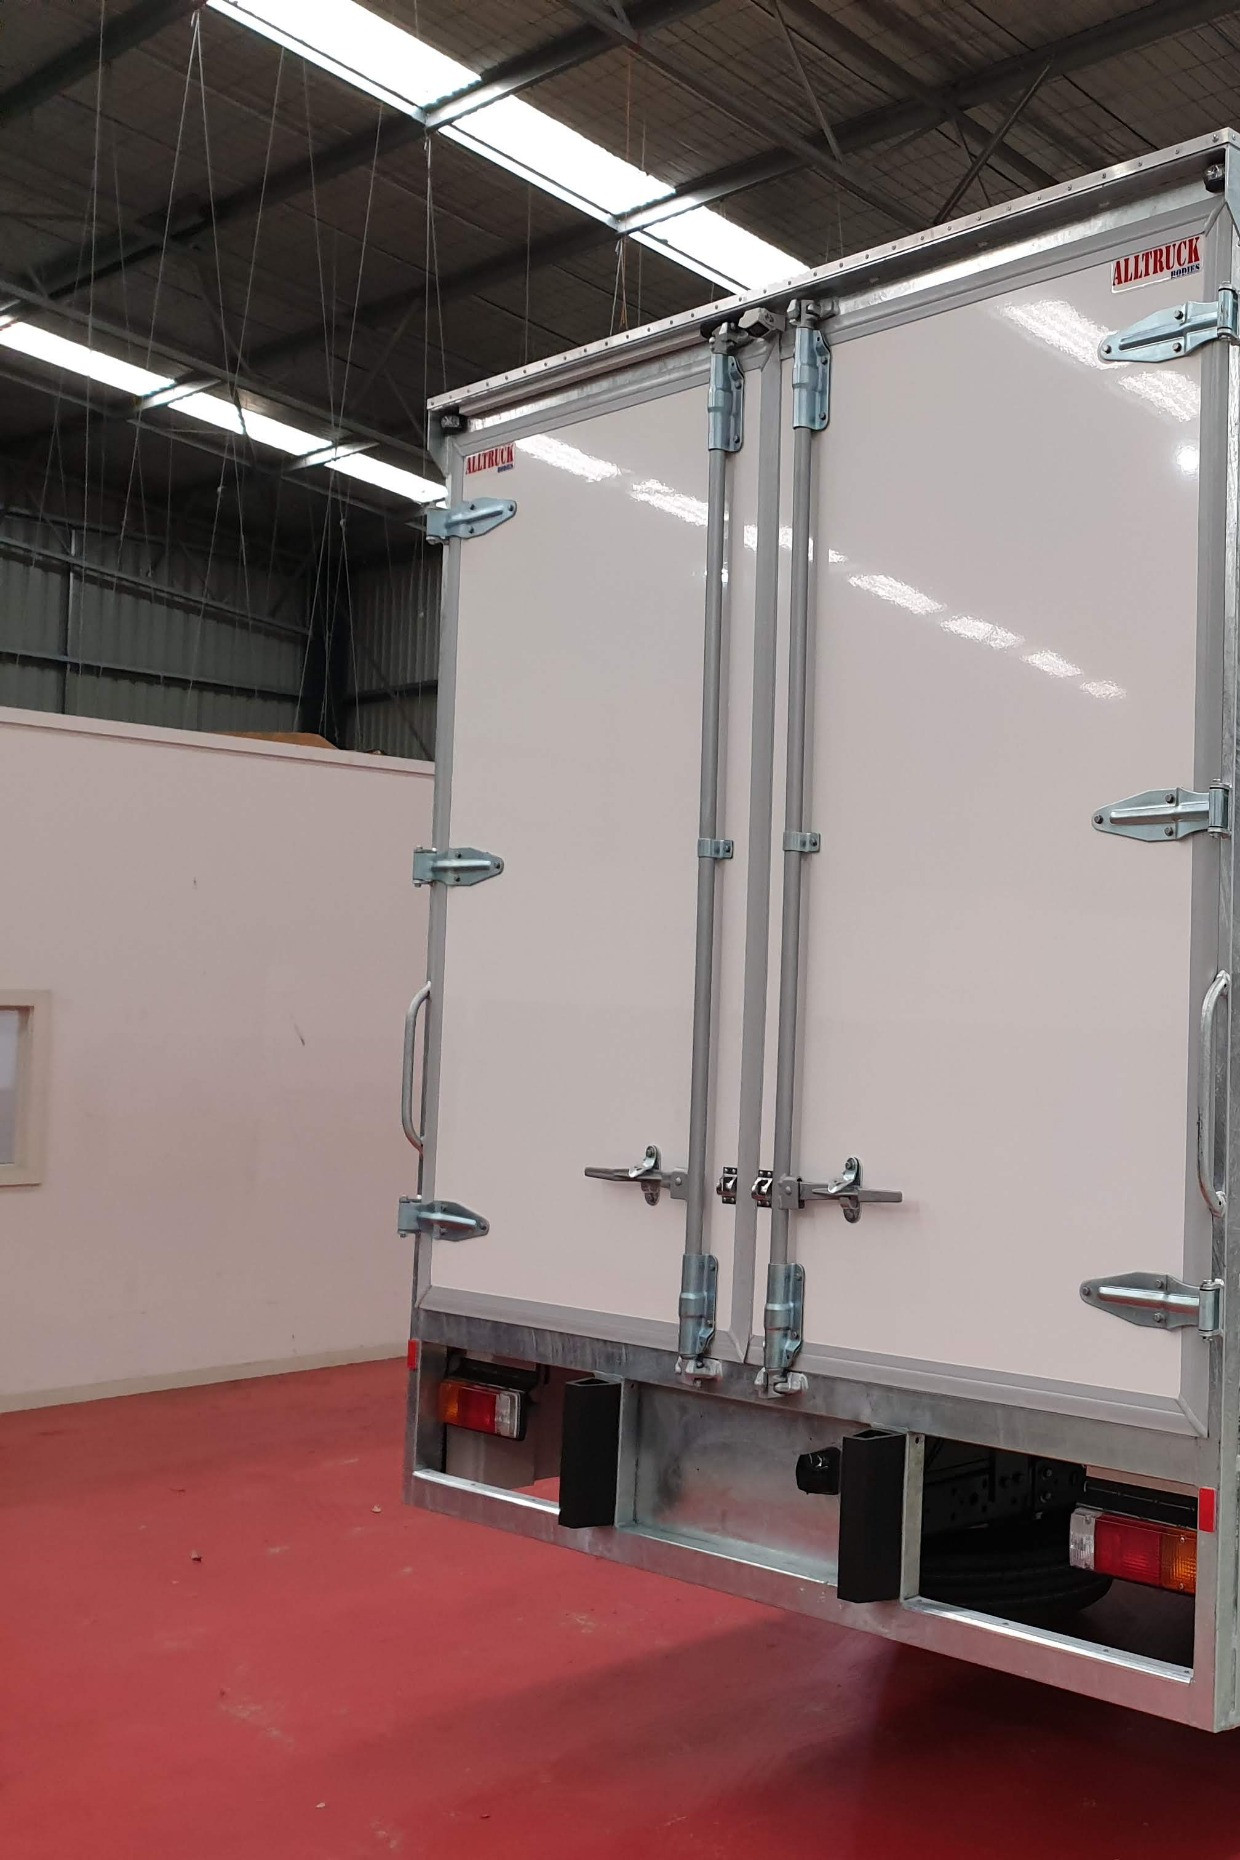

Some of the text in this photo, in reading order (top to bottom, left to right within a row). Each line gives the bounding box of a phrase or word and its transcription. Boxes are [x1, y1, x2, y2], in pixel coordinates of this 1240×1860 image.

[1113, 236, 1200, 286] ALLTRUCK
[1170, 264, 1200, 280] BODIES
[465, 444, 513, 475] ALLTRUCK
